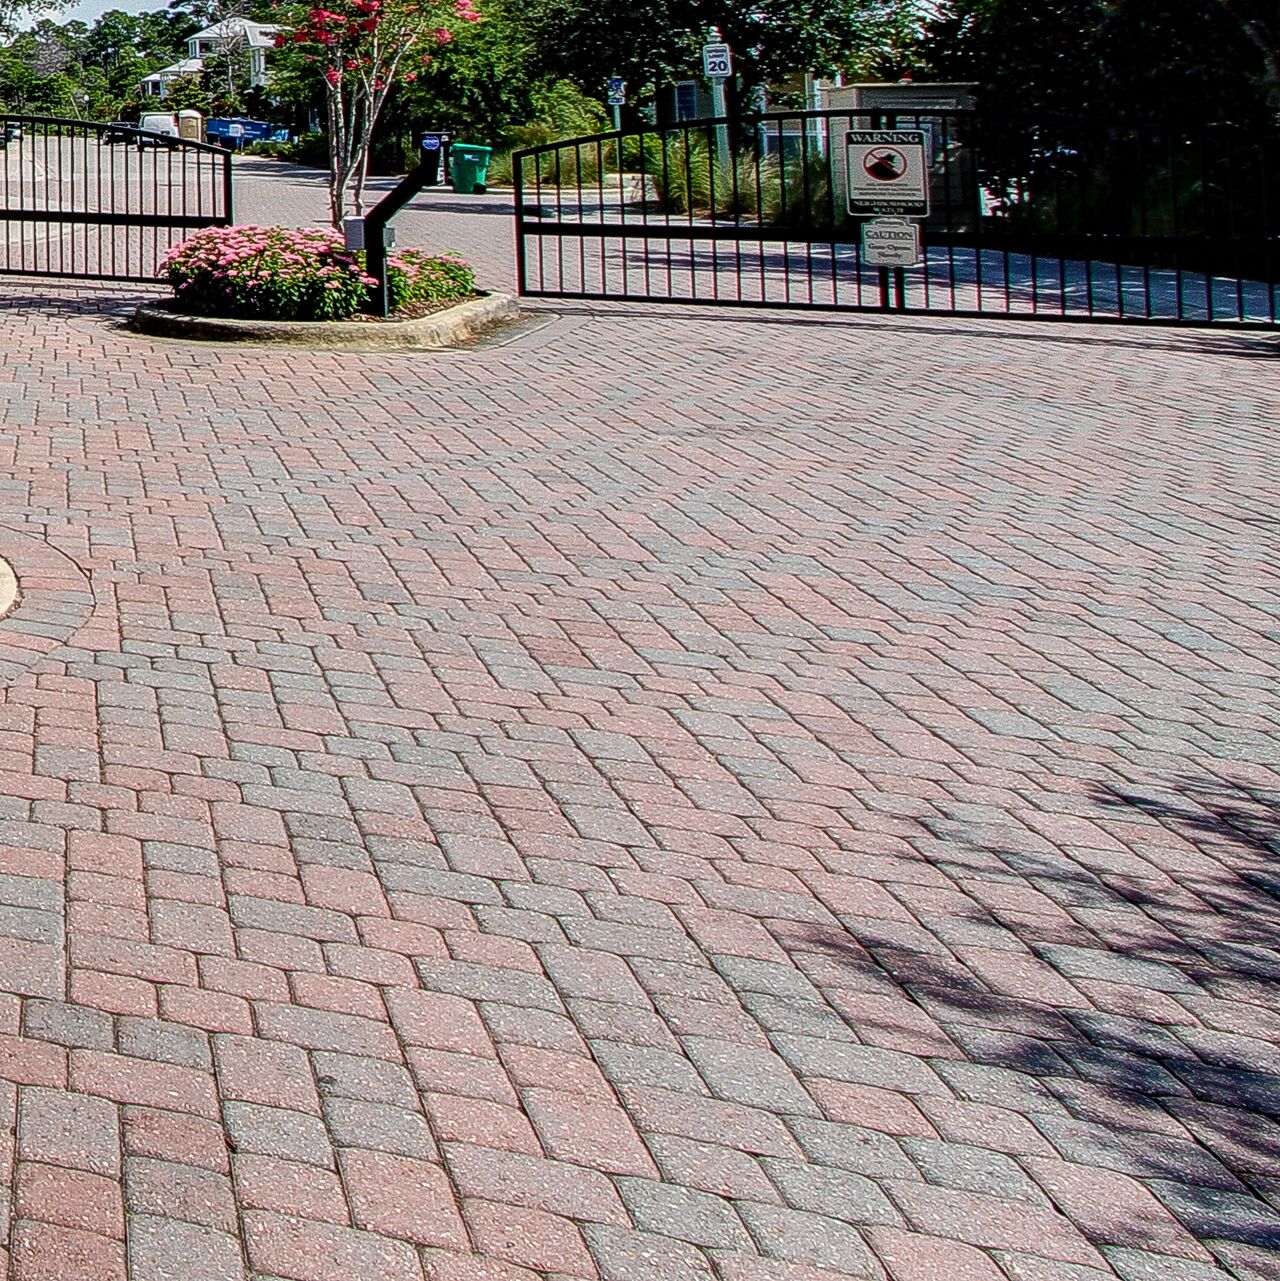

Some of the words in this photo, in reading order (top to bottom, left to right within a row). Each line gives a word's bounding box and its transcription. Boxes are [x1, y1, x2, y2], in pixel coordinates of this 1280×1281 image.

[708, 60, 728, 72] 20
[850, 133, 920, 143] WARNING
[864, 230, 914, 241] CAUTION
